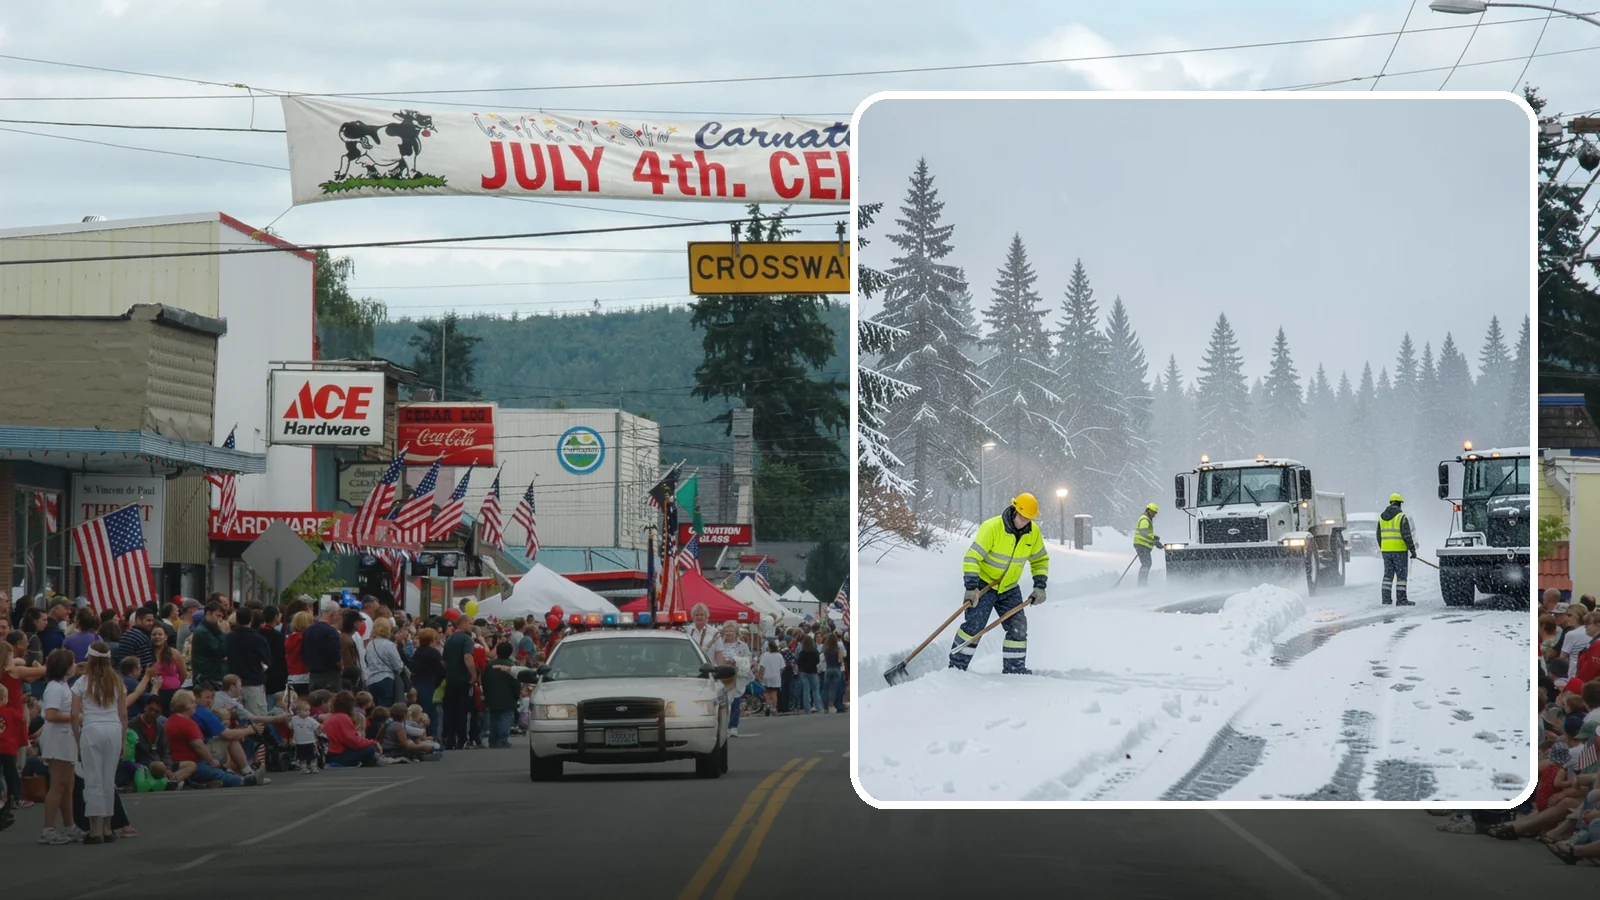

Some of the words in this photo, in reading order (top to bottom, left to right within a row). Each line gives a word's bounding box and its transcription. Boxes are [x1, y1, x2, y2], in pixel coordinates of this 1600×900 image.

[694, 121, 850, 150] Carnat
[481, 141, 605, 192] JULY
[632, 150, 746, 197] 4th.
[697, 254, 850, 280] CROSSWA
[282, 380, 373, 420] ACE
[405, 409, 452, 422] CEDAR
[283, 421, 371, 436] Hardware
[416, 428, 477, 447] Coca-Cola
[353, 467, 386, 481] Simpl
[96, 485, 124, 495] Vincent
[126, 485, 135, 495] de
[138, 486, 155, 495] Paul
[212, 516, 330, 535] HARDARE
[688, 526, 741, 535] CRNATION
[699, 535, 730, 543] GLASS
